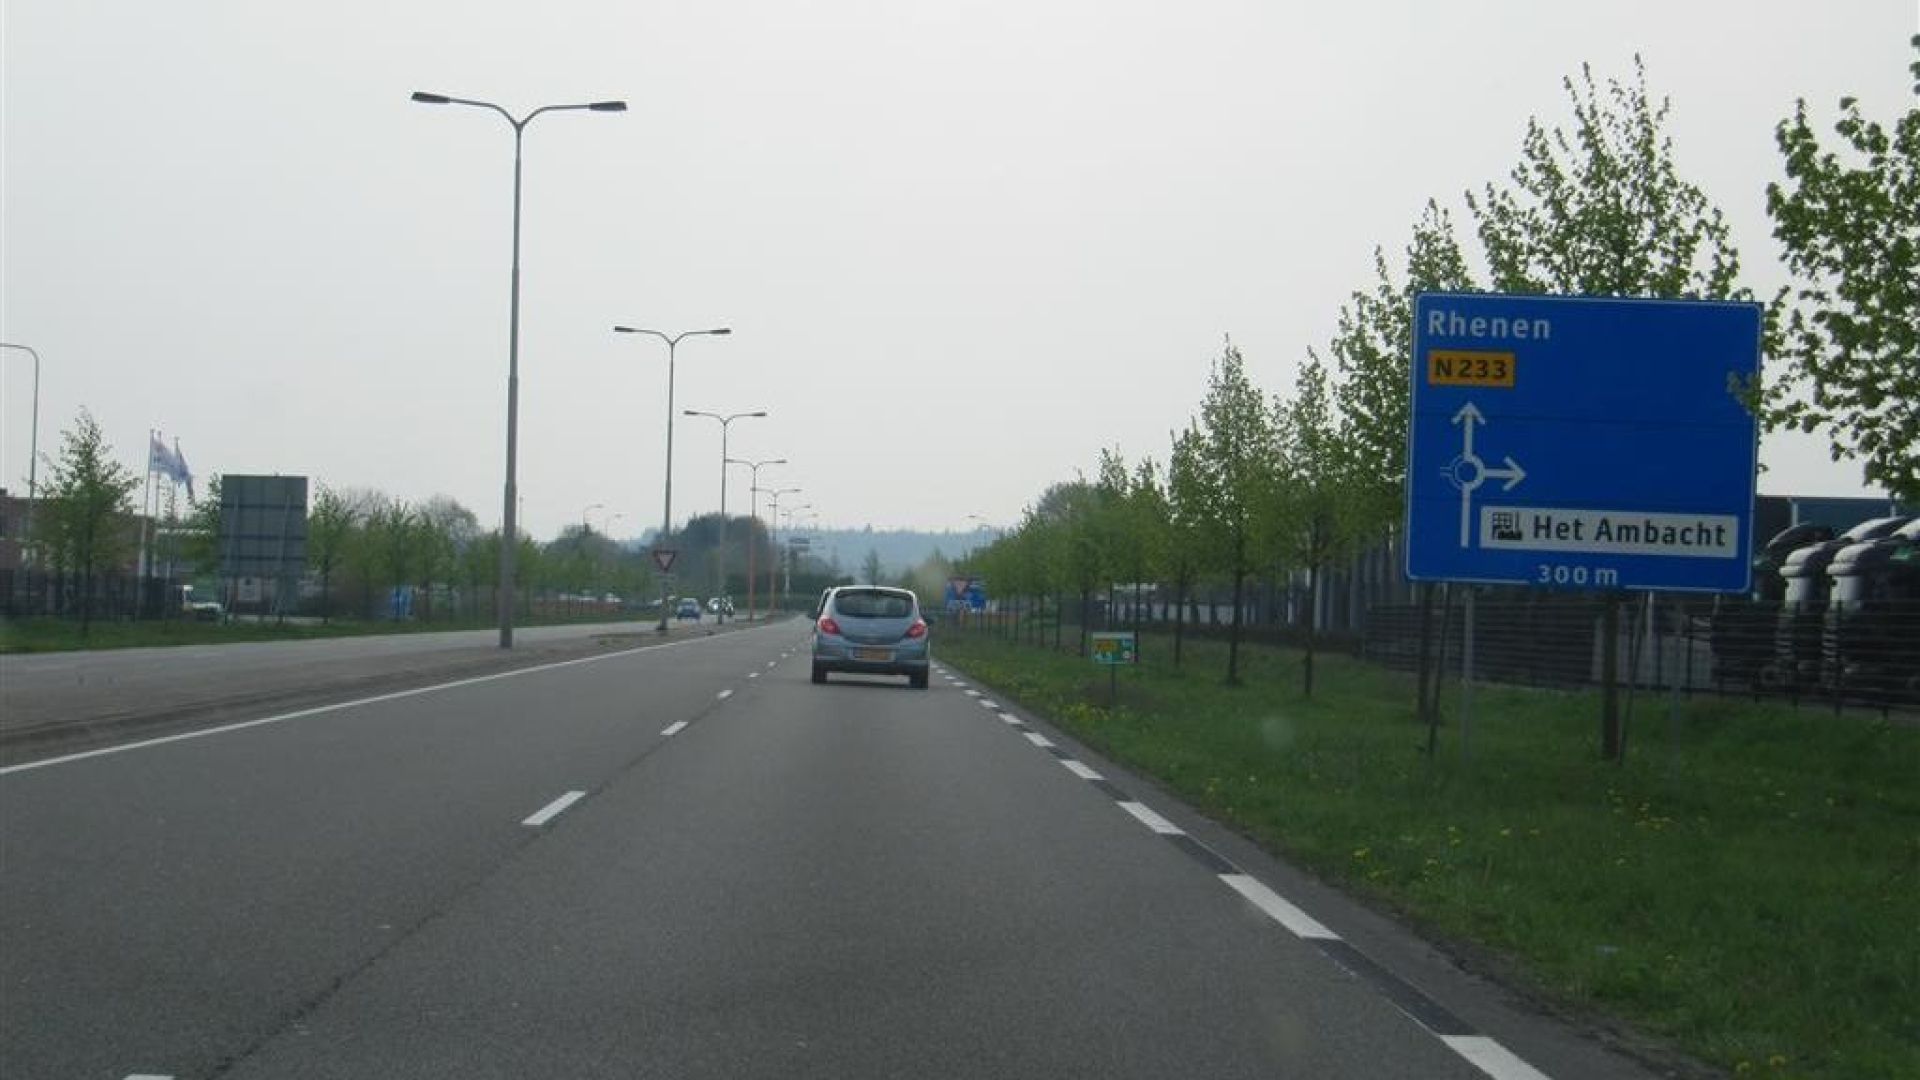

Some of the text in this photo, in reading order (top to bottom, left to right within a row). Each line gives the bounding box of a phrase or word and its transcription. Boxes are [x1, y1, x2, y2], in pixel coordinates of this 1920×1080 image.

[1428, 311, 1550, 339] Rhenen
[1533, 515, 1726, 546] Het Ambacht
[1538, 564, 1618, 585] 300 m
